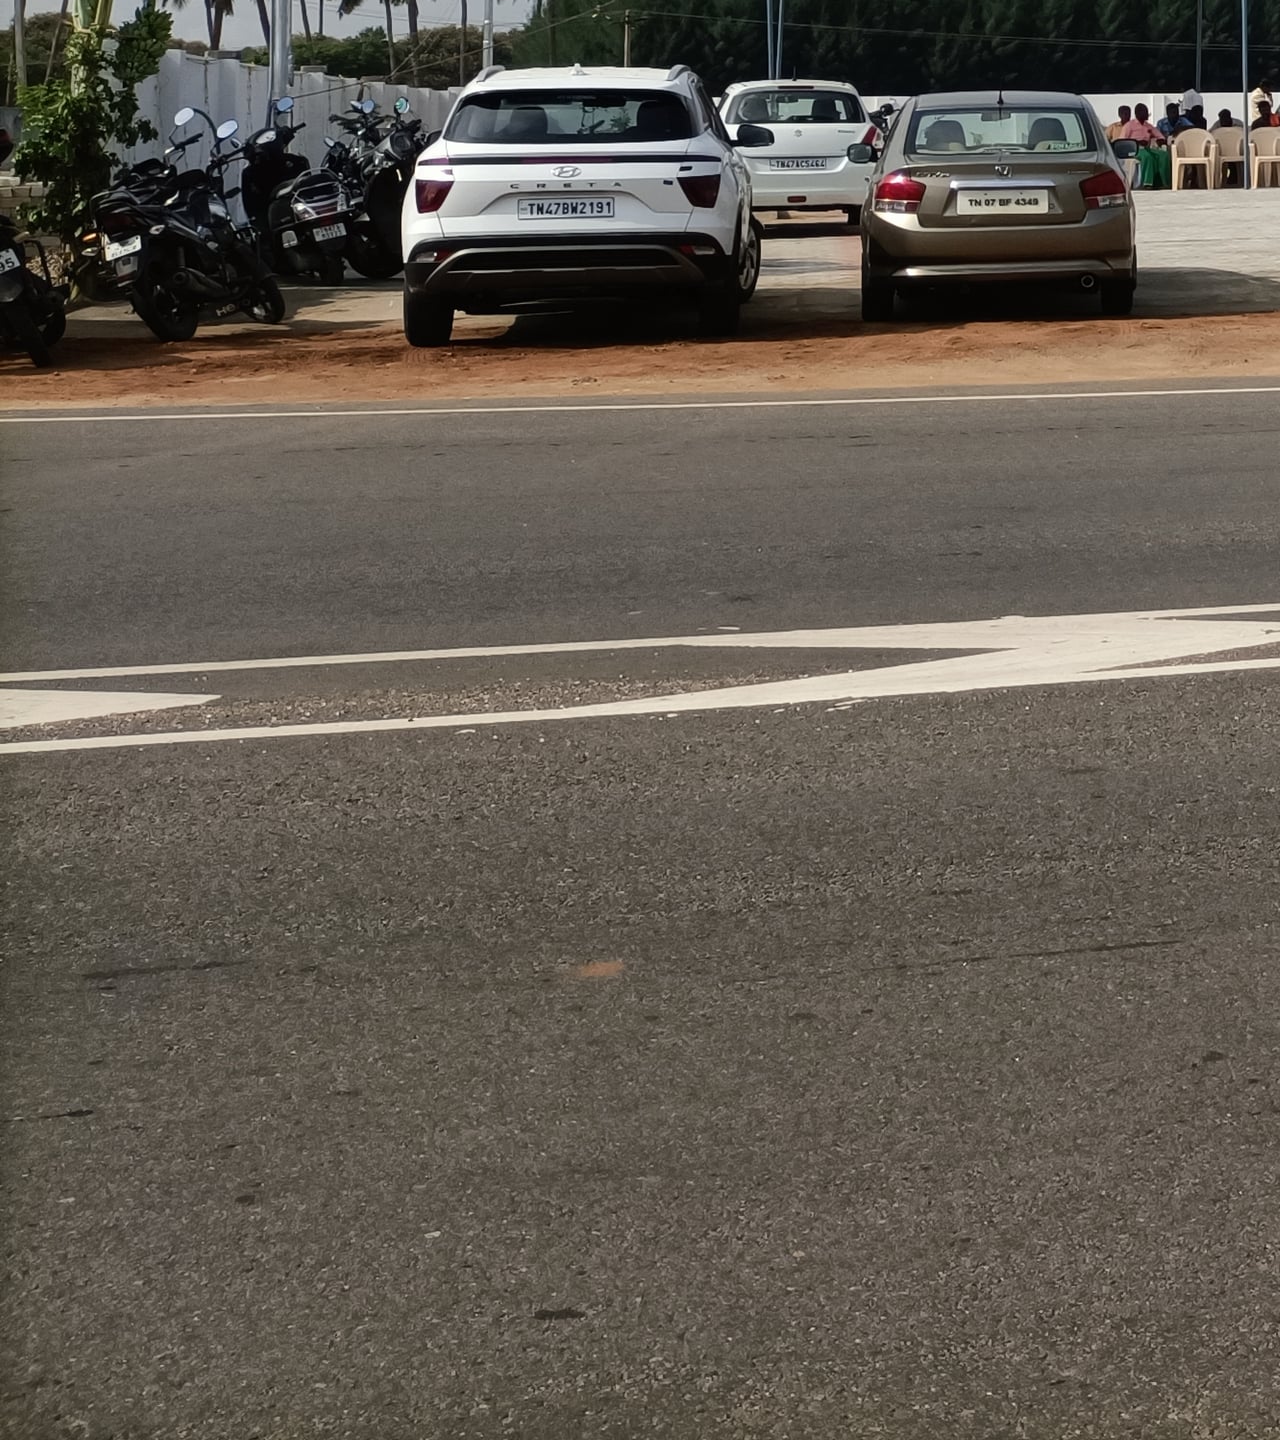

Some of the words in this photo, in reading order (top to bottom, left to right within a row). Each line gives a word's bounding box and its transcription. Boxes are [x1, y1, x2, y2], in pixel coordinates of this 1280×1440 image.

[528, 201, 612, 216] TN47BW2191
[968, 198, 982, 207] TN
[984, 198, 995, 207] 07
